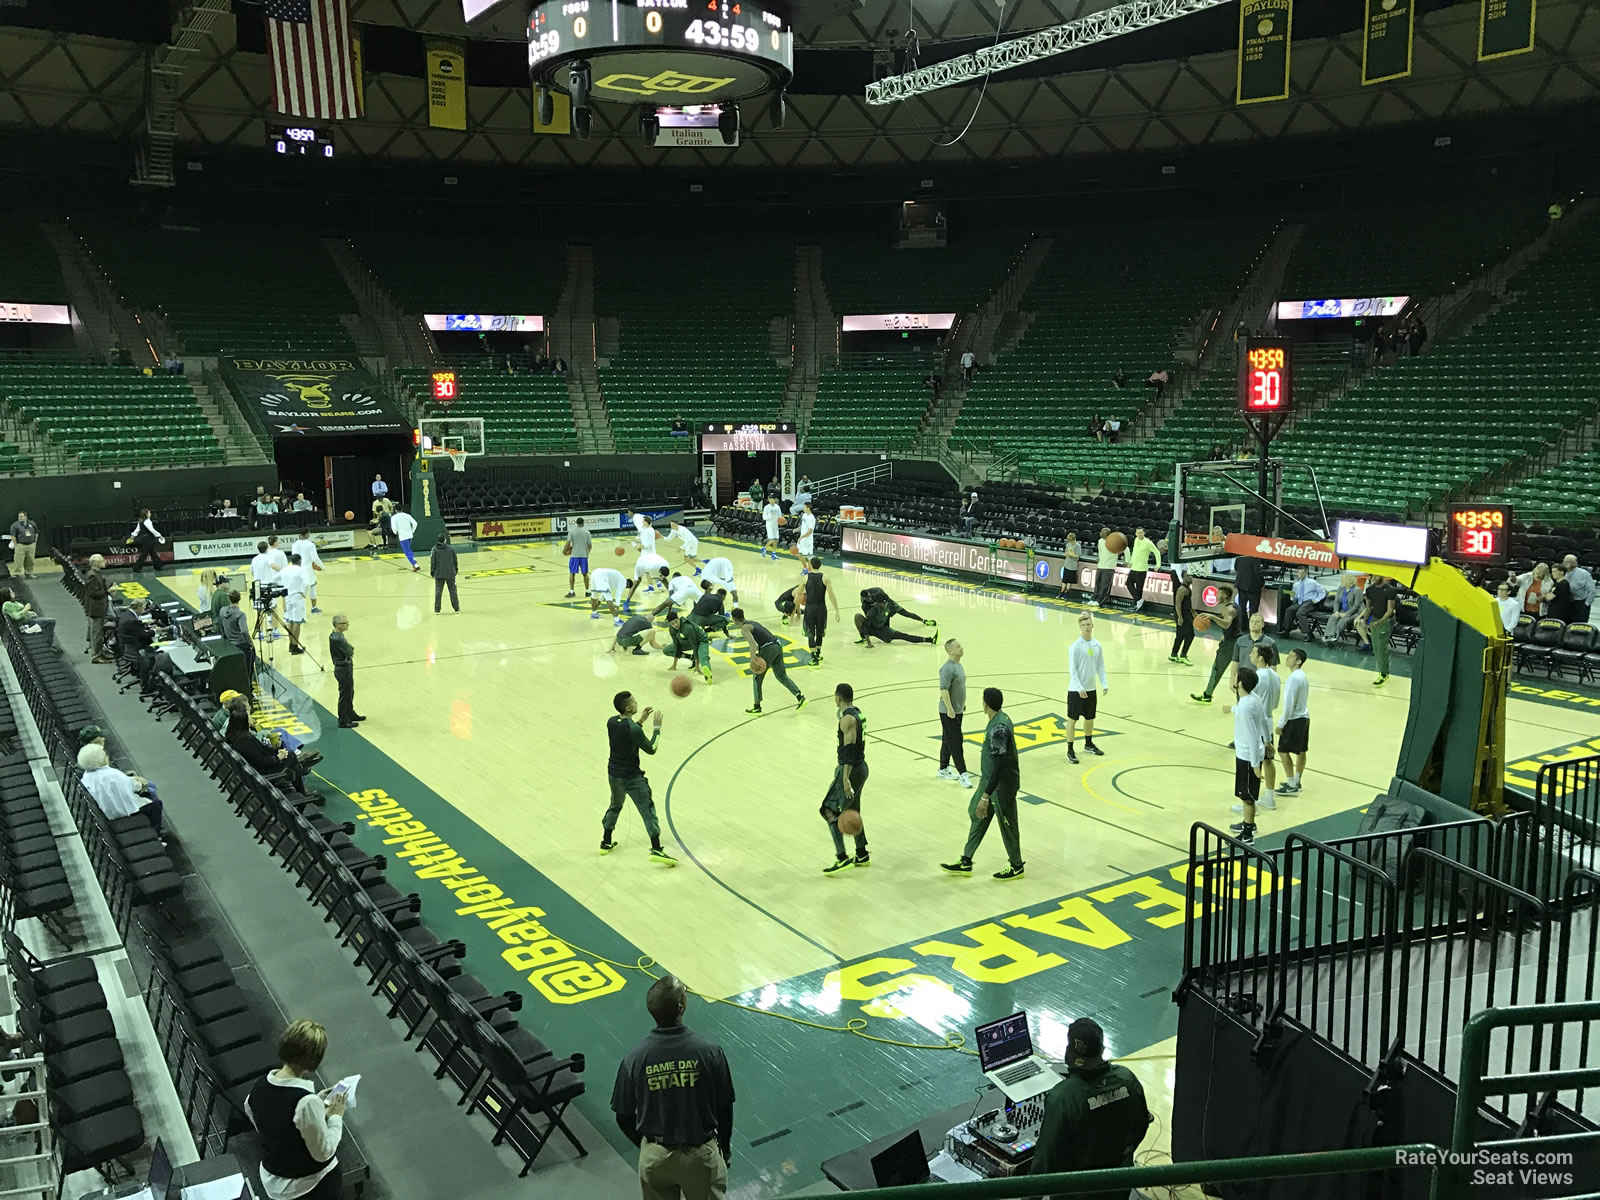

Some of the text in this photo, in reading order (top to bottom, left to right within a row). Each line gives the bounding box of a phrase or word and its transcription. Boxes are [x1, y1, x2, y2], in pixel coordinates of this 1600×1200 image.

[1244, 0, 1288, 17] BAYLOR
[574, 17, 587, 38] 0
[646, 11, 662, 33] 0
[685, 19, 759, 52] 43:59
[771, 30, 780, 51] 0
[671, 129, 703, 138] Italian
[676, 137, 713, 146] Granite
[276, 140, 286, 154] 0
[324, 145, 334, 158] 0
[233, 359, 356, 371] BAYLOR
[1249, 349, 1284, 369] 43:59
[432, 372, 455, 382] 43:59
[436, 382, 453, 397] 30
[1254, 371, 1280, 406] 30
[267, 408, 383, 417] BAYLORBEARS.COM
[723, 441, 776, 451] BASKETBALL
[784, 457, 793, 495] BEARS
[1455, 511, 1504, 529] 43:59
[109, 546, 138, 555] Waco
[1465, 530, 1493, 554] 30
[854, 531, 1009, 575] Welcome to the Ferrell Center
[348, 788, 628, 1005] @BaylorAthletics
[645, 1059, 699, 1075] GAME DAY
[647, 1071, 701, 1092] STAFF
